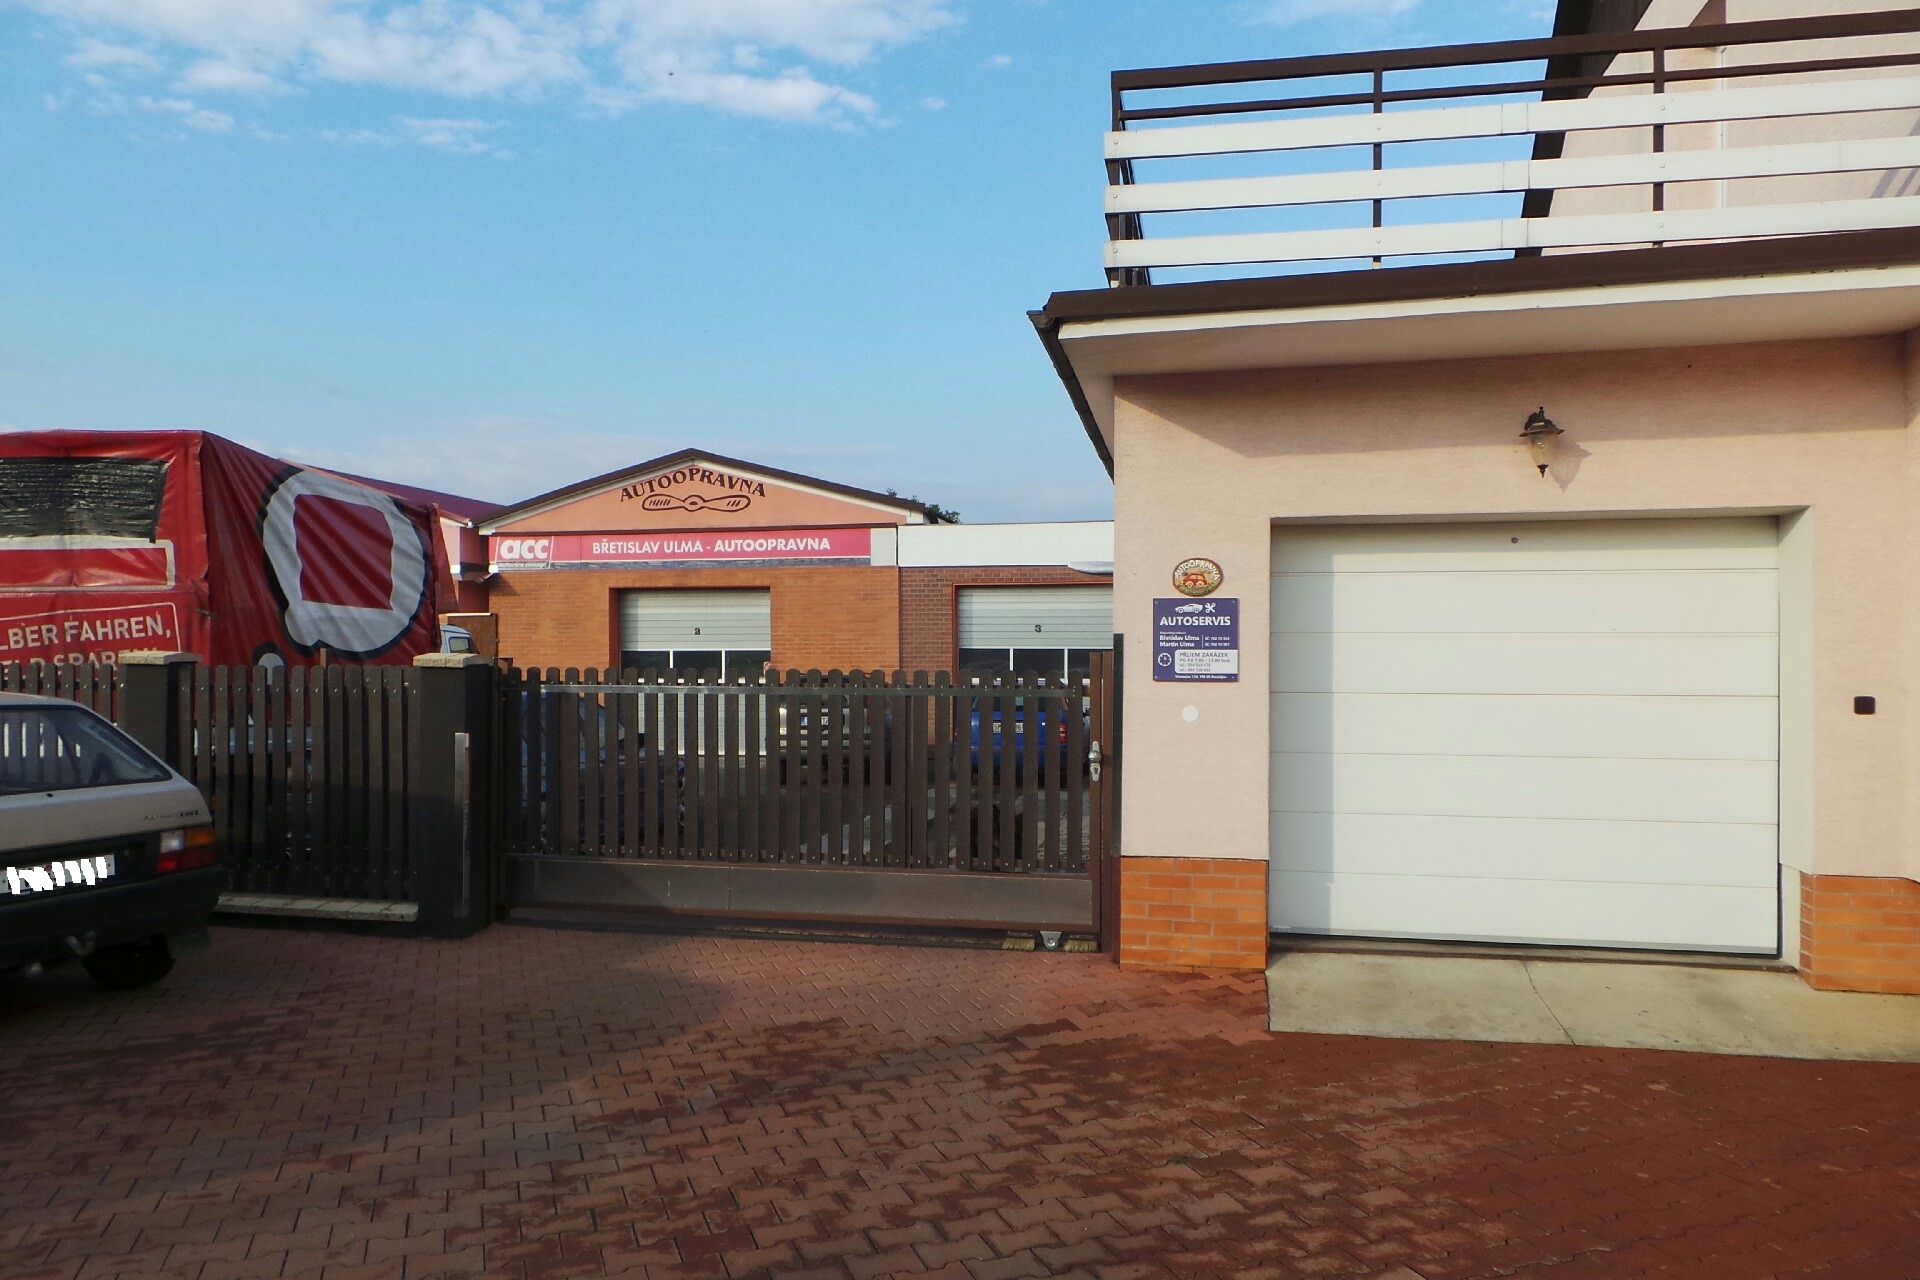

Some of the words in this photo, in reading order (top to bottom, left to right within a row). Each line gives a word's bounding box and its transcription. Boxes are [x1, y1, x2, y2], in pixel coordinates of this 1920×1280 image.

[620, 467, 766, 502] AUTOOPRAVNA
[500, 539, 548, 560] acc
[592, 538, 661, 555] BŘETISLAV
[664, 540, 703, 554] ULMA
[714, 537, 831, 552] AUTOOPRAVNA
[1174, 560, 1220, 581] AUTOOPRAVNA
[65, 614, 171, 643] FAHREN,
[1034, 624, 1042, 633] 3
[1159, 616, 1231, 626] AUTOSERVIS
[694, 627, 701, 636] 2
